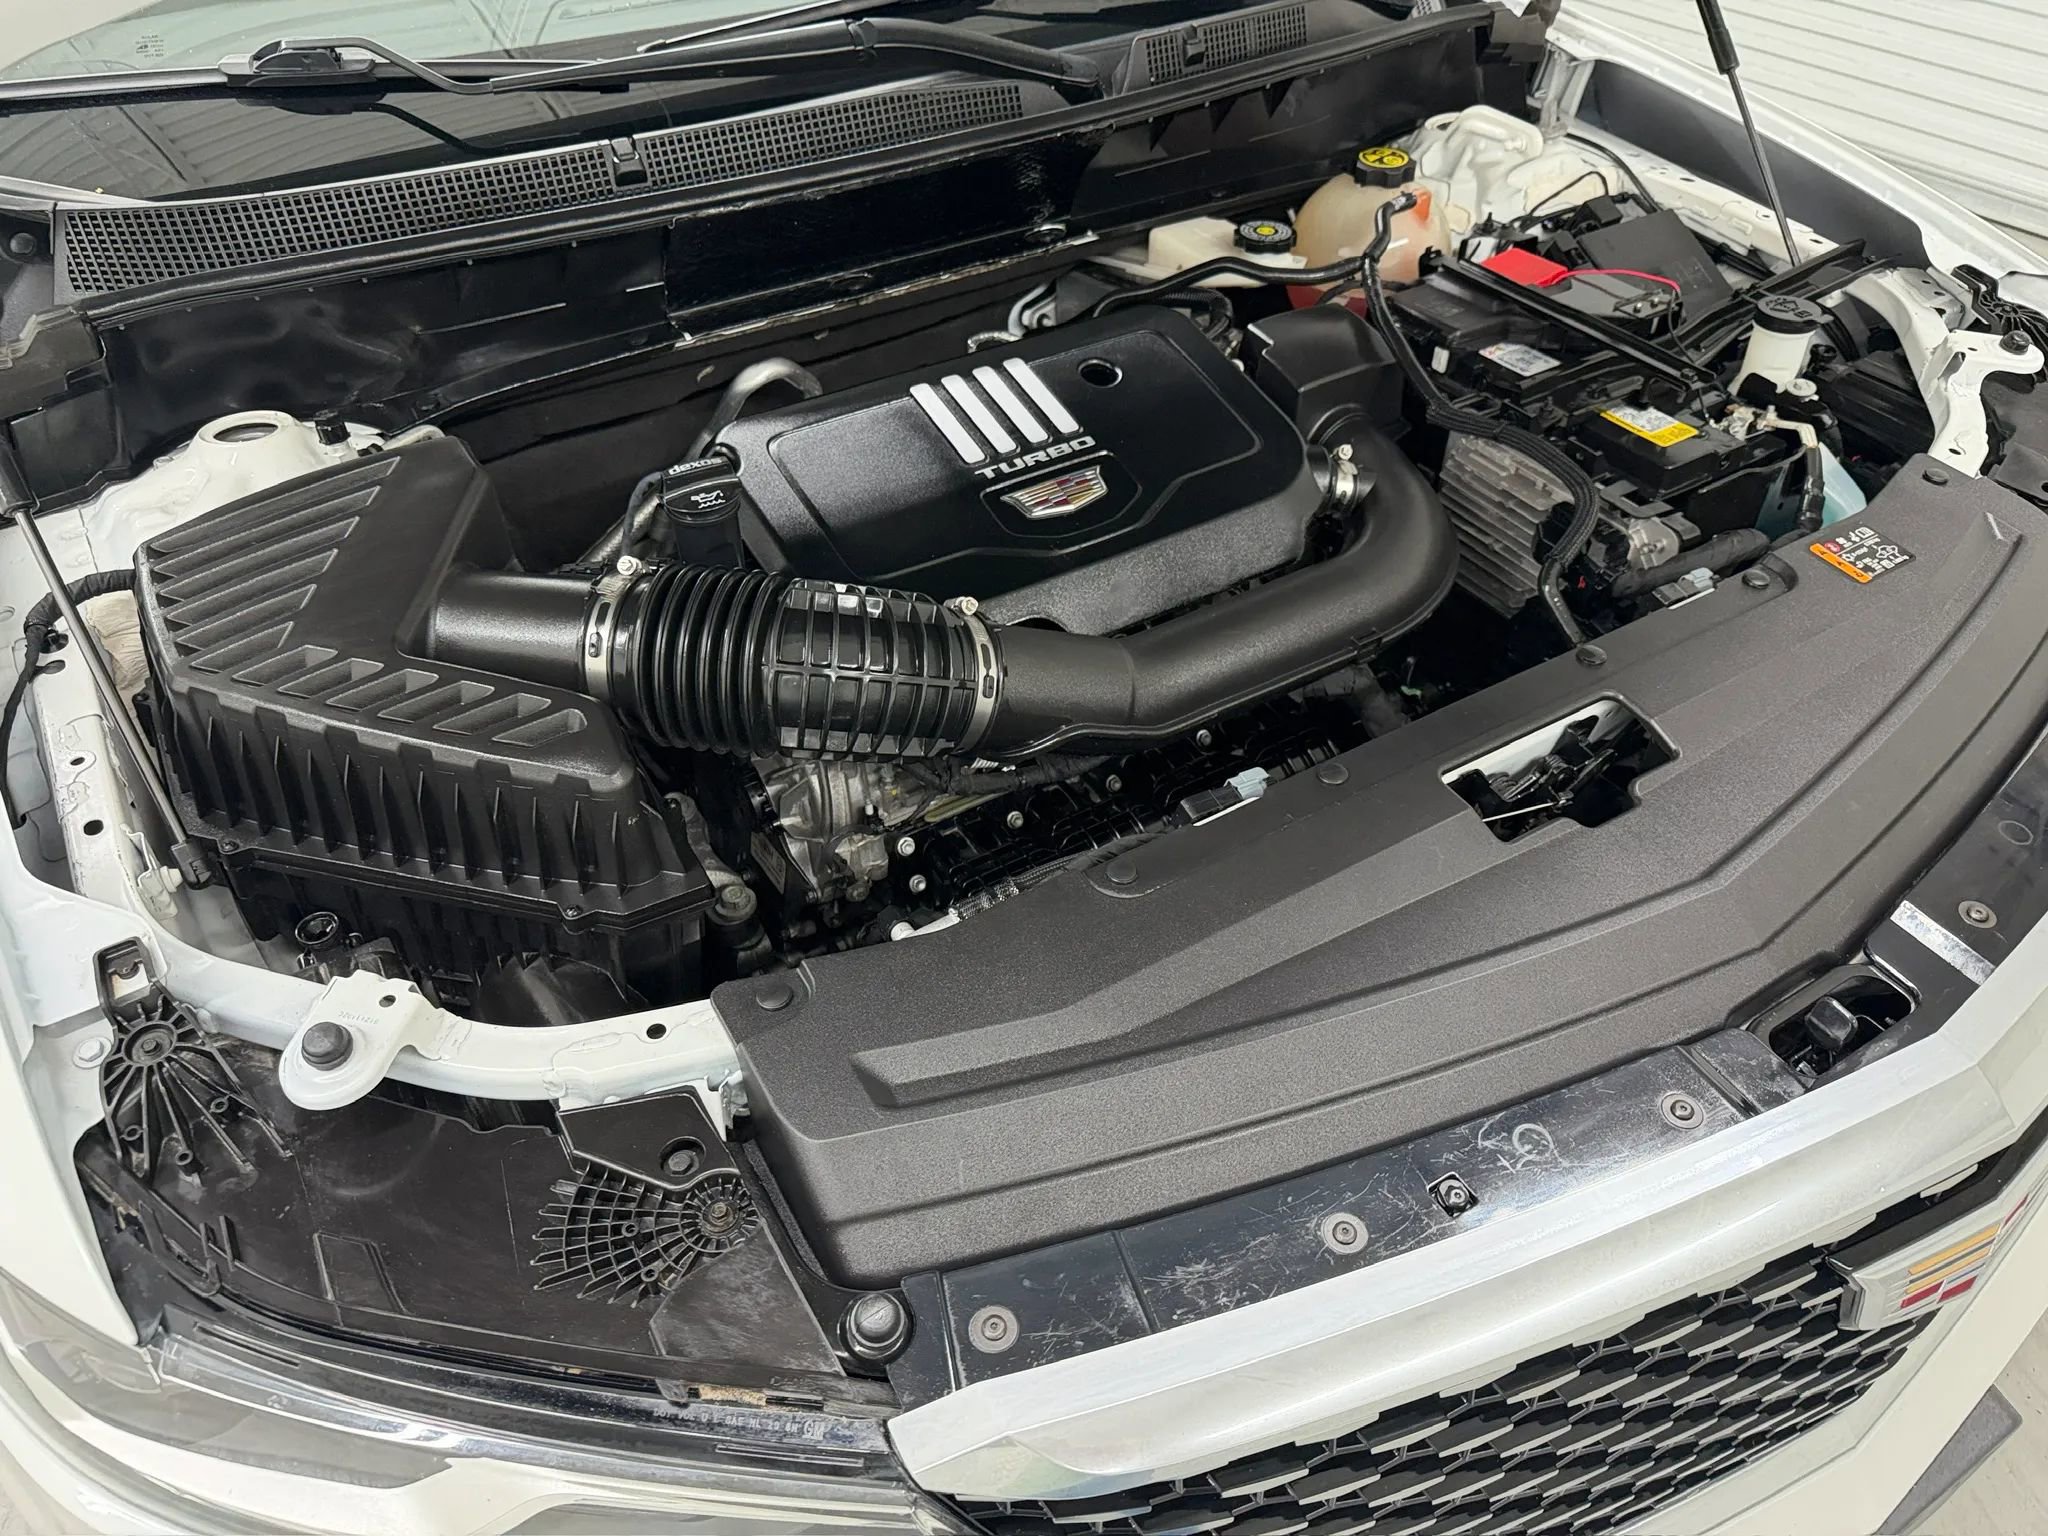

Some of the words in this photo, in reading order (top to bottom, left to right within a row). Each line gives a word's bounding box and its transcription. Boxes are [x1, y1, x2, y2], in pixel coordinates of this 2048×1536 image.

[668, 458, 723, 475] dexos
[974, 435, 1097, 480] TURBO
[802, 1419, 825, 1440] GM
